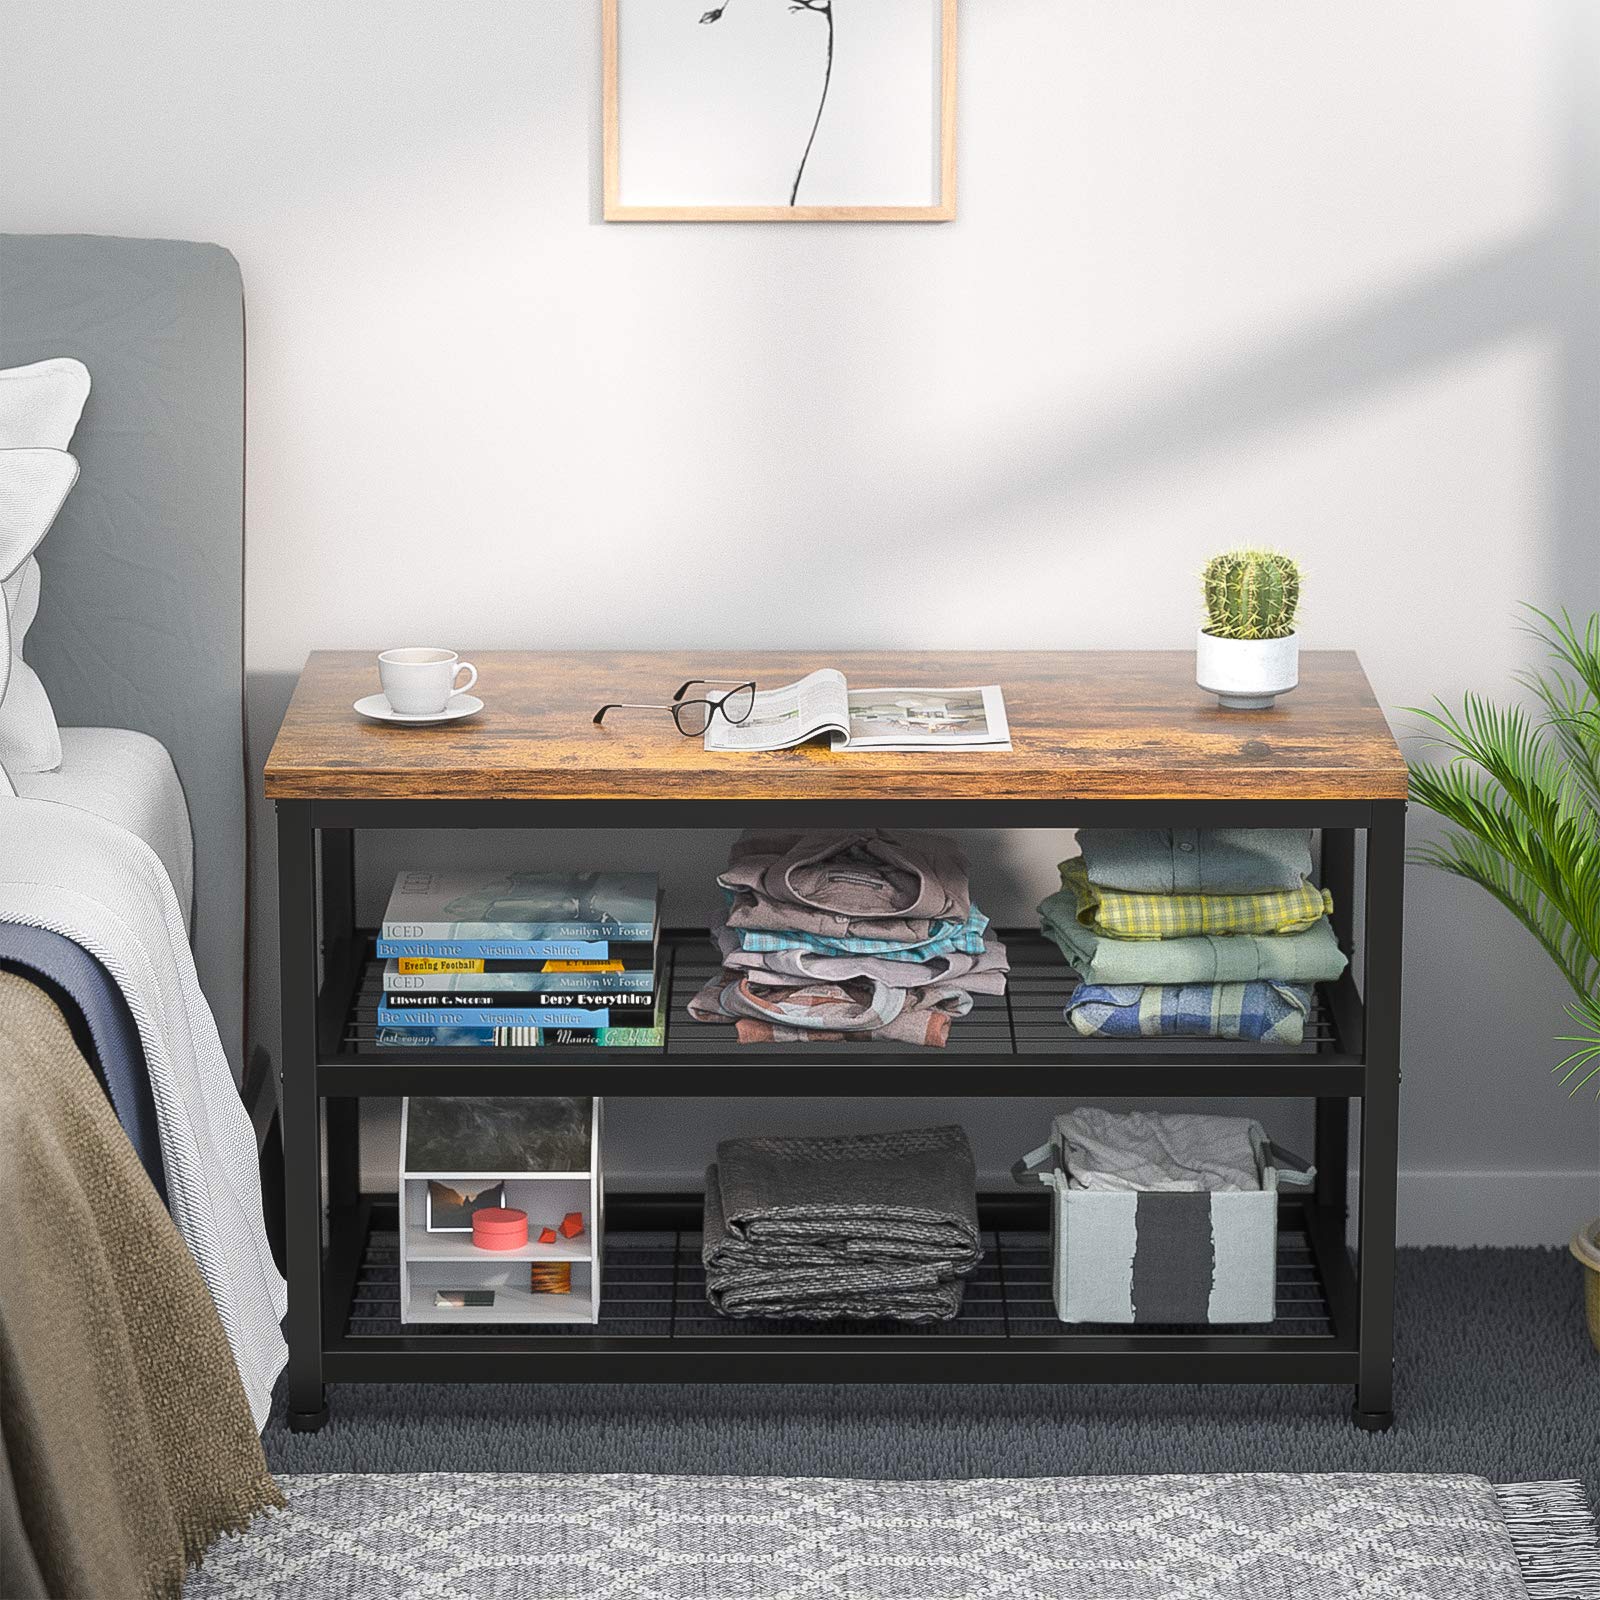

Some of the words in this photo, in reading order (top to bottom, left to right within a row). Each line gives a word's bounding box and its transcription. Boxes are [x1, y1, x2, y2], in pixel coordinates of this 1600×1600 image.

[387, 926, 424, 937] ICED
[560, 927, 600, 938] Marilyn
[602, 927, 616, 936] W.
[618, 927, 650, 936] Foster
[380, 943, 399, 955] Be
[402, 943, 436, 955] with
[439, 945, 463, 955] me
[479, 944, 524, 956] Virginia
[404, 962, 438, 971] Evening
[441, 961, 475, 970] Football
[388, 977, 425, 988] ICED
[560, 977, 600, 988] Marilyn
[602, 978, 616, 987] W.
[618, 978, 650, 987] Foster
[540, 994, 574, 1006] Deny
[577, 994, 652, 1006] Everything
[381, 1011, 400, 1023] Be
[404, 1011, 438, 1023] with
[441, 1013, 464, 1023] me
[479, 1012, 525, 1025] Virginia
[556, 1029, 600, 1044] Maurice
